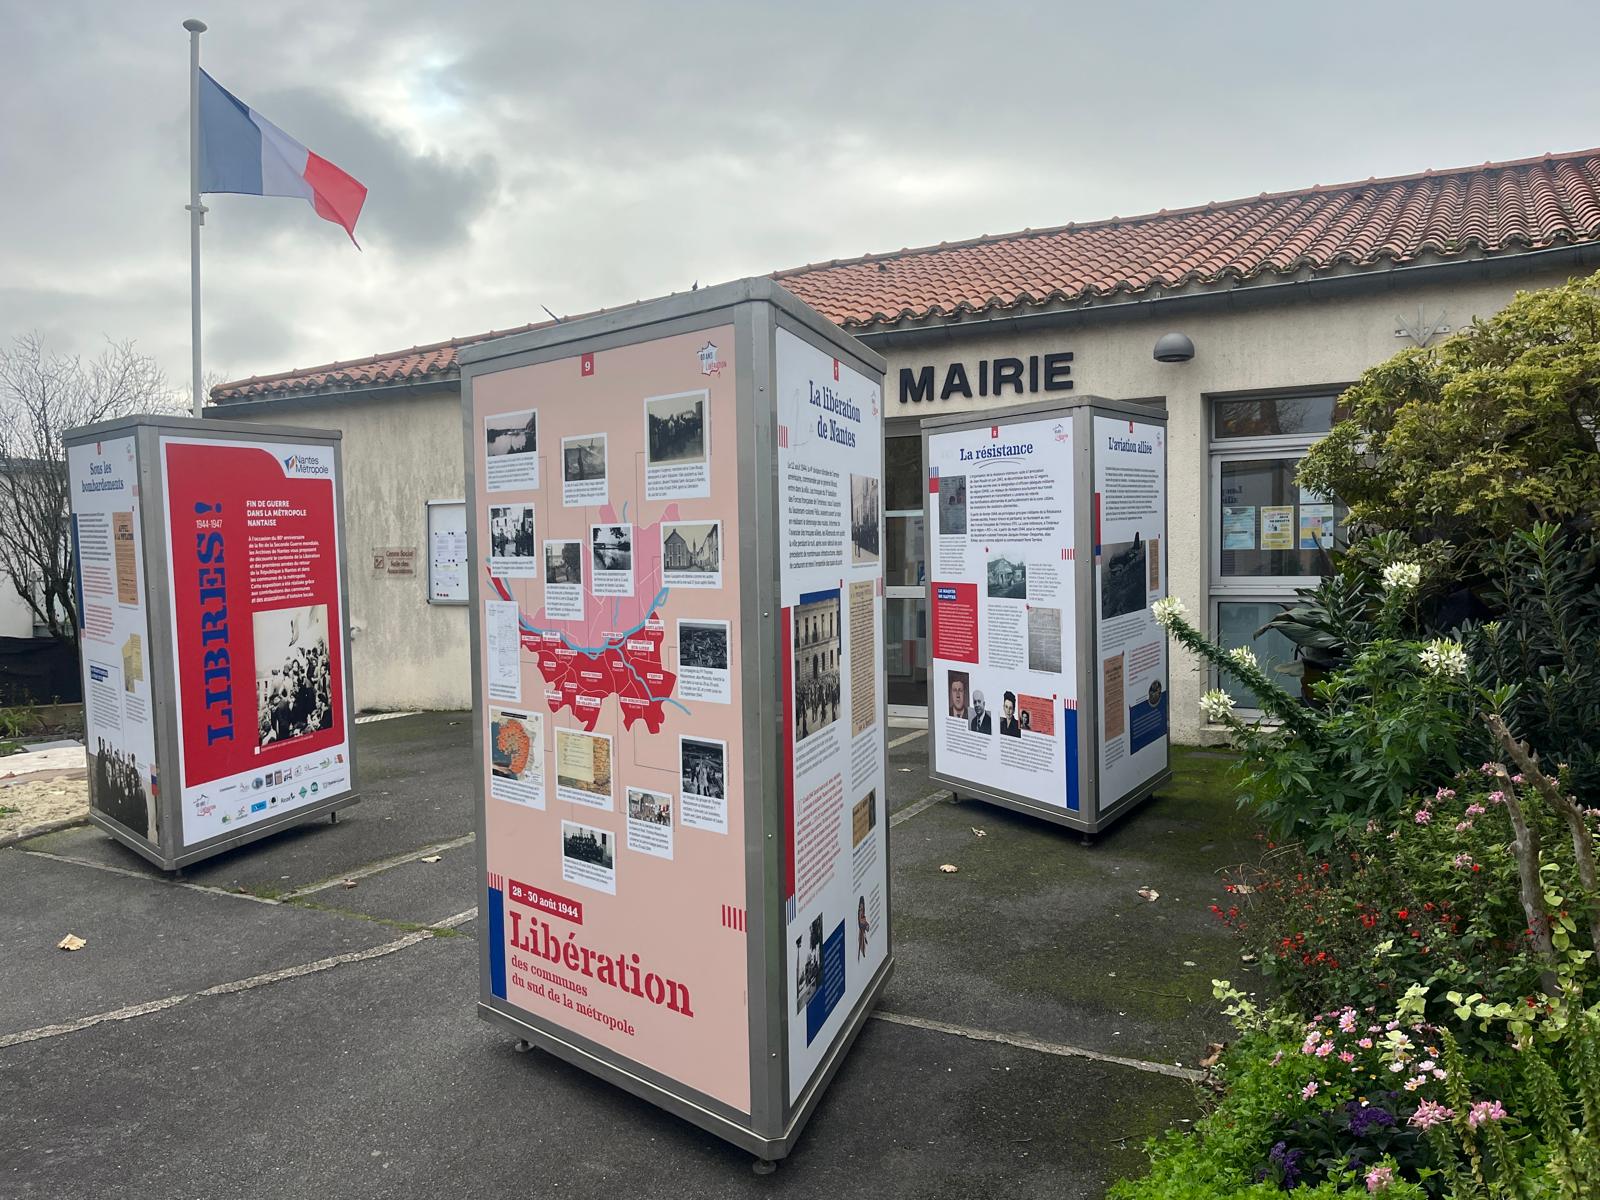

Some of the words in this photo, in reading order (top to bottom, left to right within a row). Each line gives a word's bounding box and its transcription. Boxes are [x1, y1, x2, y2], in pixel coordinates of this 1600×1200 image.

[585, 361, 590, 371] 9
[900, 352, 1073, 403] MAIRIE
[809, 380, 821, 407] La
[823, 386, 861, 423] libération
[818, 415, 827, 439] de
[830, 418, 856, 448] Nantes
[960, 448, 973, 461] La
[976, 443, 1033, 459] résistance
[1108, 437, 1137, 453] L'aviation
[1138, 441, 1152, 454] alliée
[90, 462, 102, 475] Sous
[296, 456, 319, 464] Nantes
[296, 465, 328, 475] Métropole
[82, 478, 124, 492] bombardements
[196, 520, 222, 529] 1944-1947
[512, 885, 522, 897] 28
[528, 891, 538, 904] 30
[540, 897, 557, 911] août
[558, 903, 579, 918] 1944
[509, 910, 694, 1018] Libération
[512, 955, 529, 972] des
[530, 964, 588, 996] communes
[512, 973, 525, 989] du
[527, 978, 545, 997] sud
[548, 988, 560, 1004] de
[563, 993, 574, 1009] la
[576, 1000, 635, 1036] métropole
